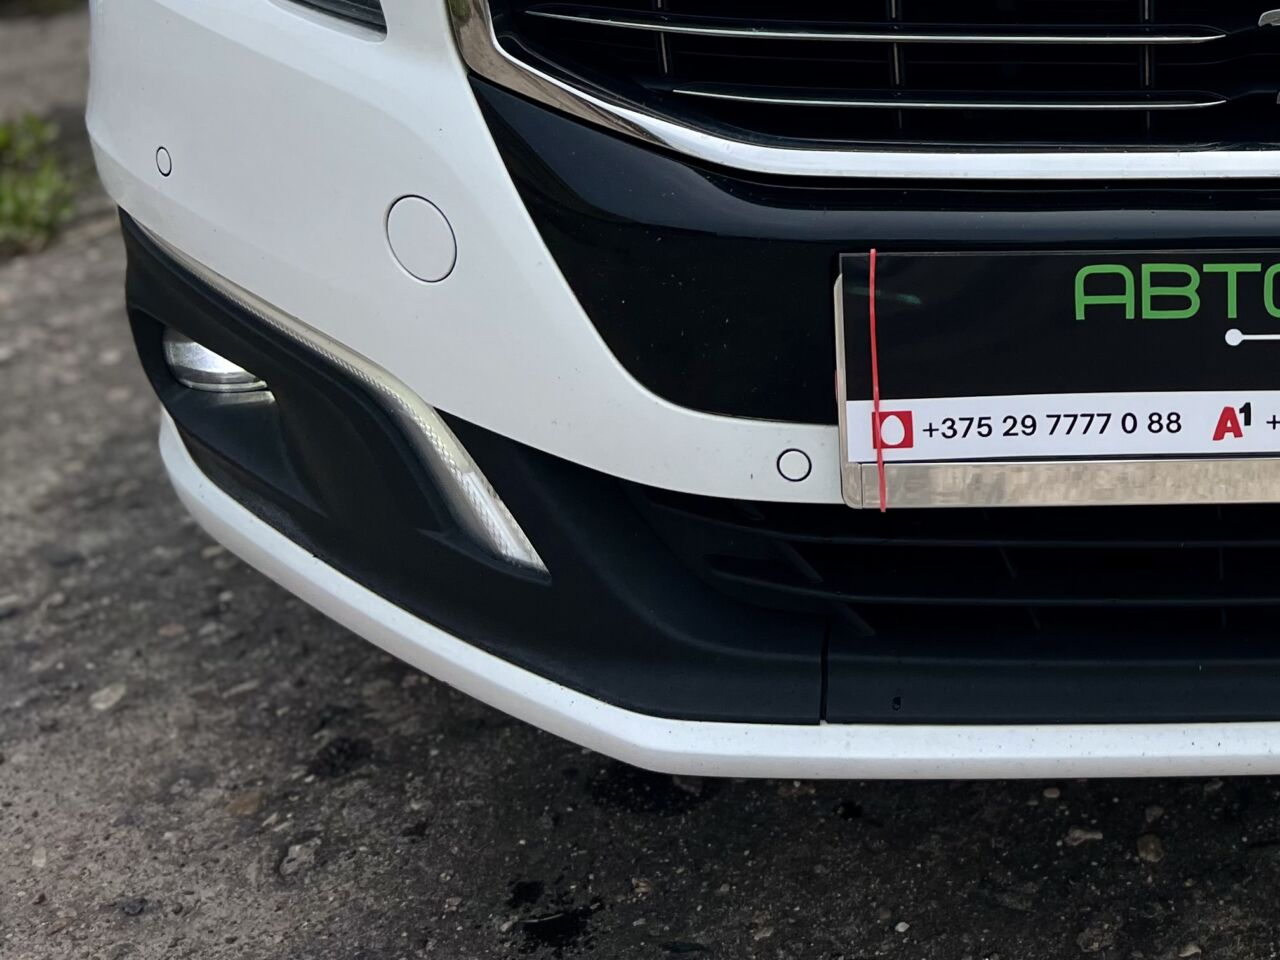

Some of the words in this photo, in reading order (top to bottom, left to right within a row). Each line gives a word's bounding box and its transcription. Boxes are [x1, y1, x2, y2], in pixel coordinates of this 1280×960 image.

[922, 416, 993, 439] +375
[1002, 414, 1037, 437] 29
[1046, 412, 1112, 435] 7777
[1120, 411, 1138, 434] 0
[1147, 411, 1182, 433] 88
